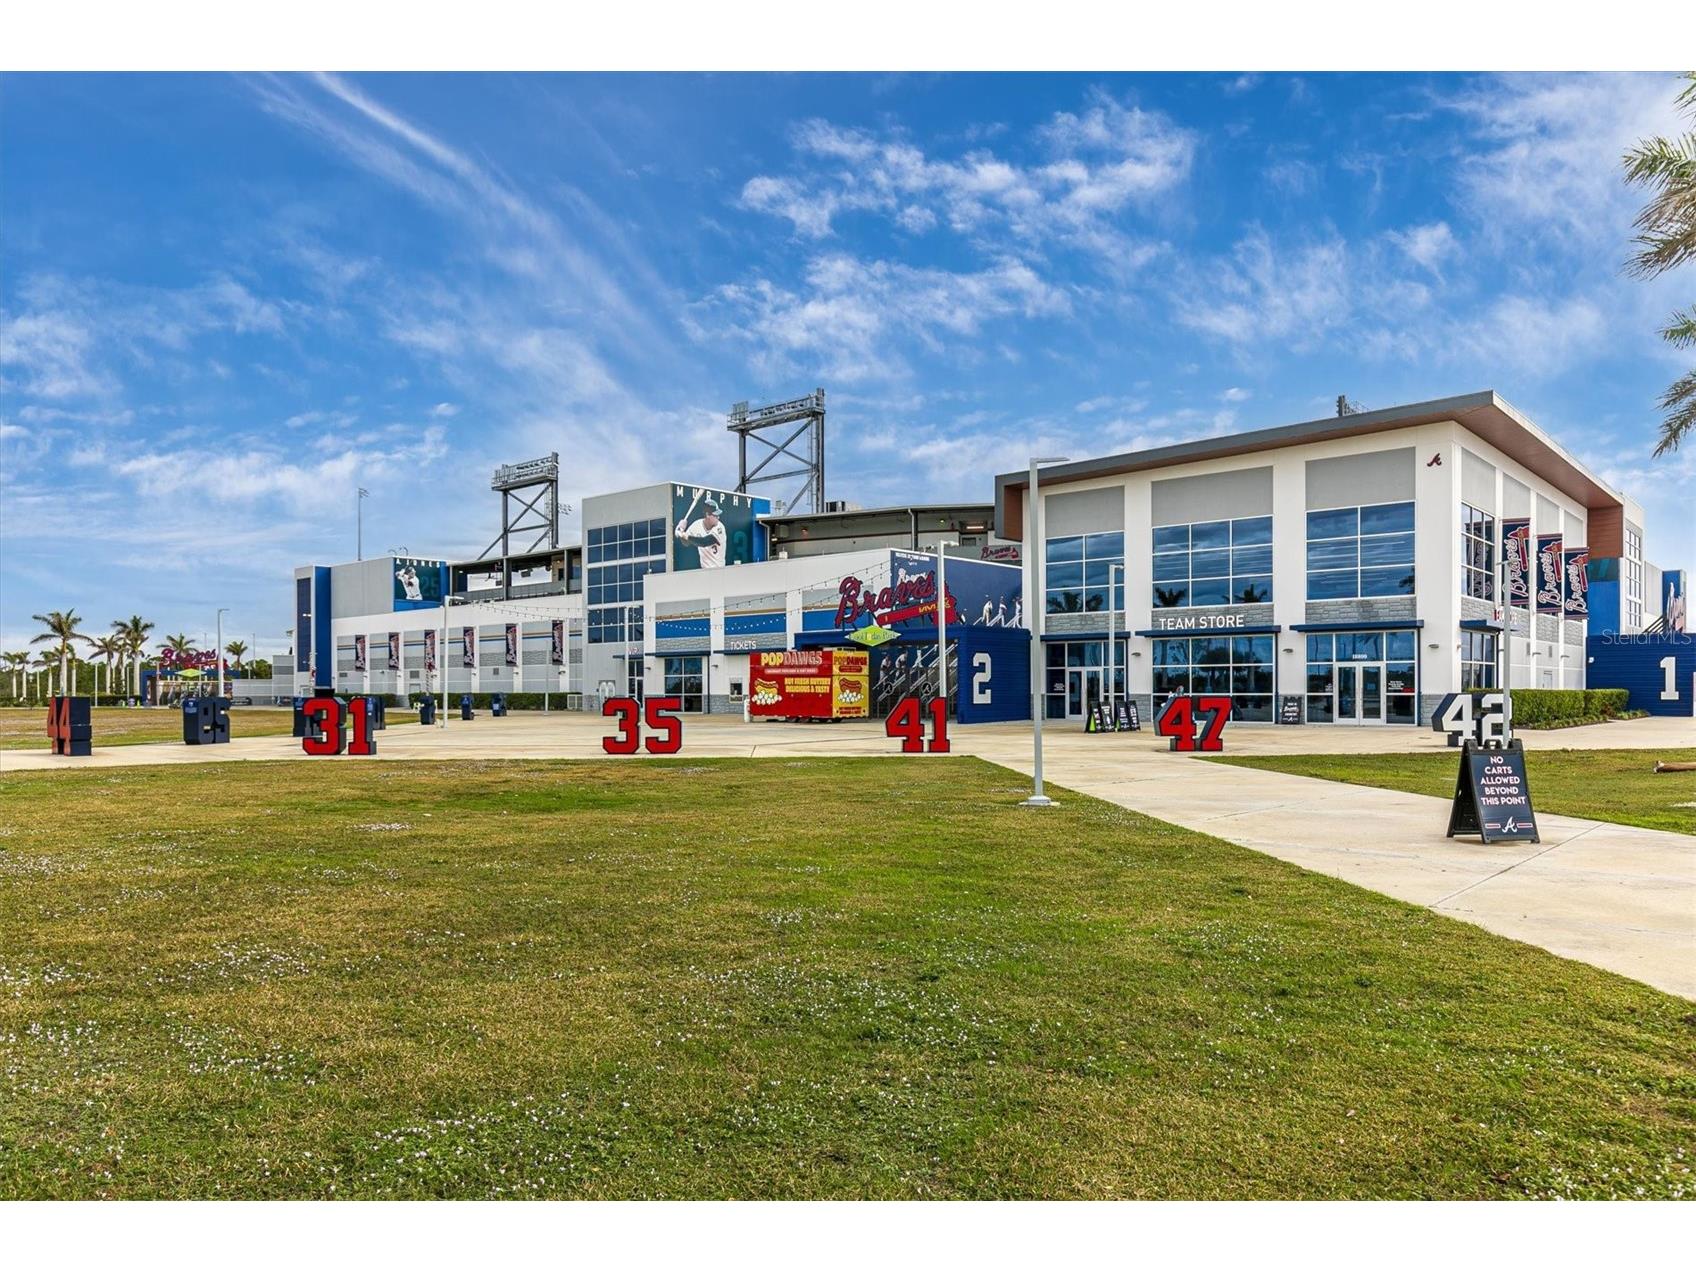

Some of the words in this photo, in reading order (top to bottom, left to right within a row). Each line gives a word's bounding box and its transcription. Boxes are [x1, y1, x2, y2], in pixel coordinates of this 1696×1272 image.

[676, 486, 752, 508] MURPHY
[835, 570, 935, 628] Braves
[1537, 552, 1562, 606] Braves
[1565, 564, 1588, 613] Braves
[730, 640, 757, 650] TICKETS
[1159, 616, 1195, 630] TEAM
[1200, 615, 1245, 629] STORE
[973, 652, 992, 704] 2
[1660, 657, 1679, 700] 1
[303, 697, 371, 755] 31
[603, 697, 682, 754] 35
[885, 697, 950, 753] 41
[1159, 696, 1232, 752] 47
[1441, 693, 1513, 748] 42
[1480, 776, 1520, 785] ALLOWED
[1484, 766, 1513, 774] CARTS
[1490, 756, 1504, 764] NO
[1481, 797, 1499, 806] THIS
[1500, 796, 1526, 805] POINT
[1484, 786, 1519, 795] BEYOND
